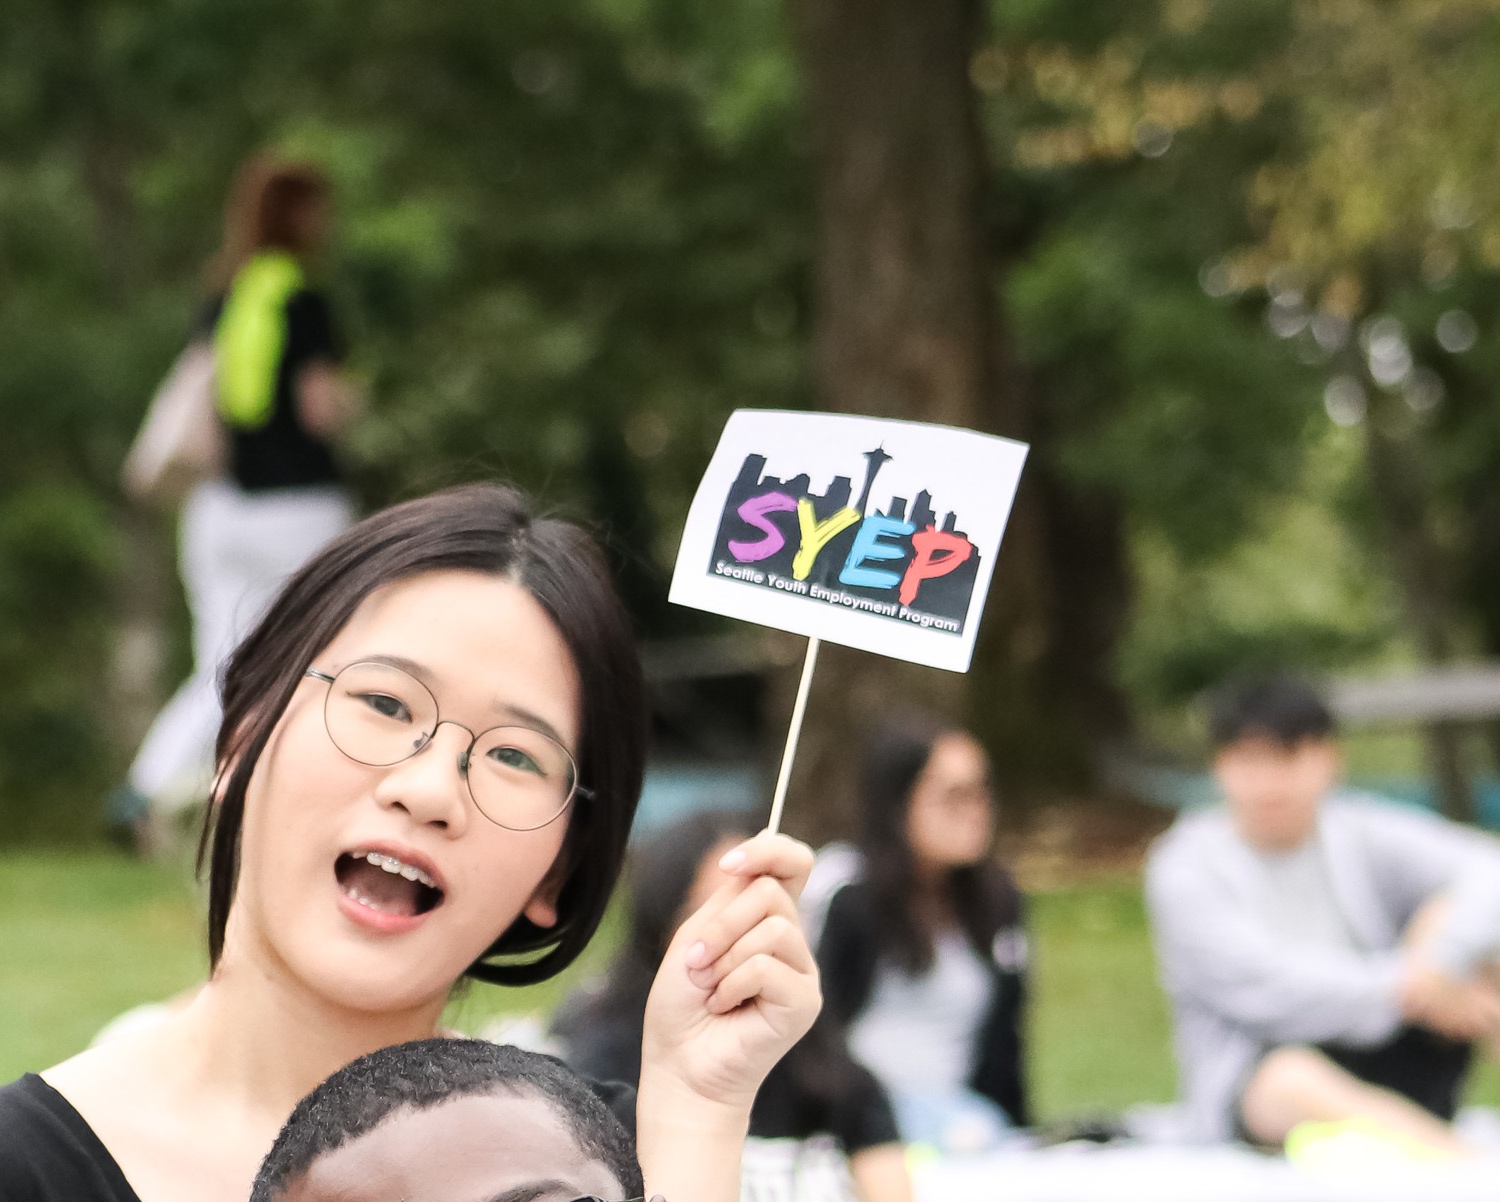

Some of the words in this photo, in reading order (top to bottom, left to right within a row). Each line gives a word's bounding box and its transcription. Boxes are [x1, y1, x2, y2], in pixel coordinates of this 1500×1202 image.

[728, 491, 972, 606] SYEP
[715, 562, 764, 585] Seattle
[767, 573, 807, 595] Youth
[809, 585, 898, 616] Employment
[899, 607, 959, 632] Program
